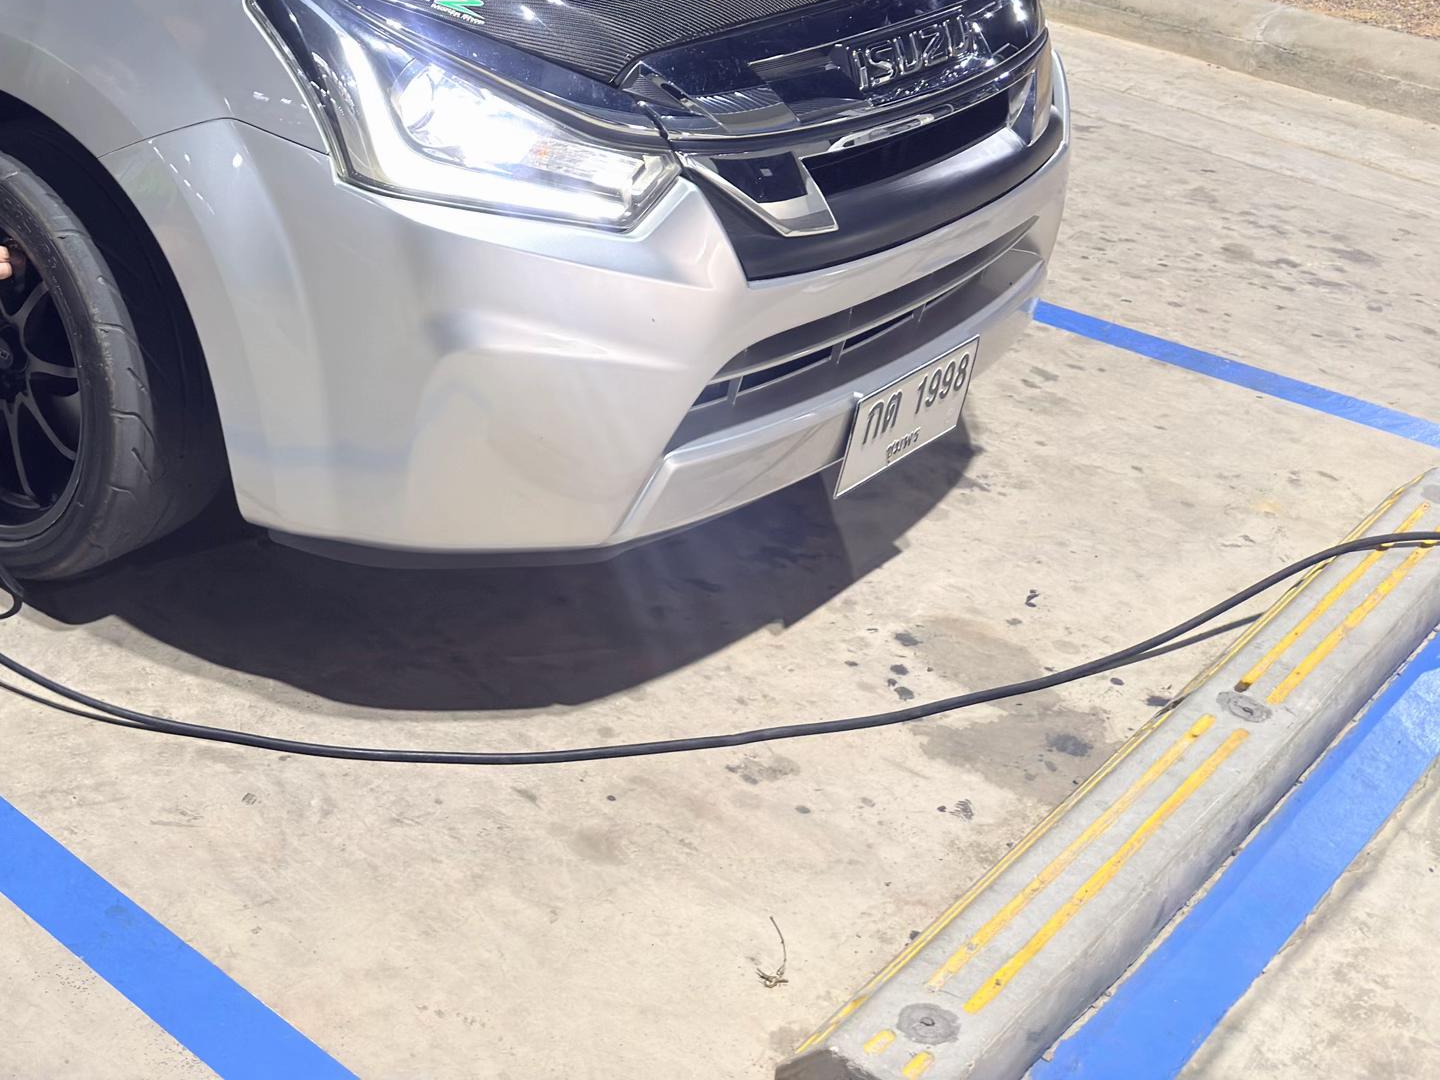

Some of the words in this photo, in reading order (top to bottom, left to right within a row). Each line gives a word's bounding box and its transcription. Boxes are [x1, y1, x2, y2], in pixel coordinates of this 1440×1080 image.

[853, 15, 973, 91] ISUZU
[862, 388, 903, 445] กต
[915, 352, 971, 415] 1998
